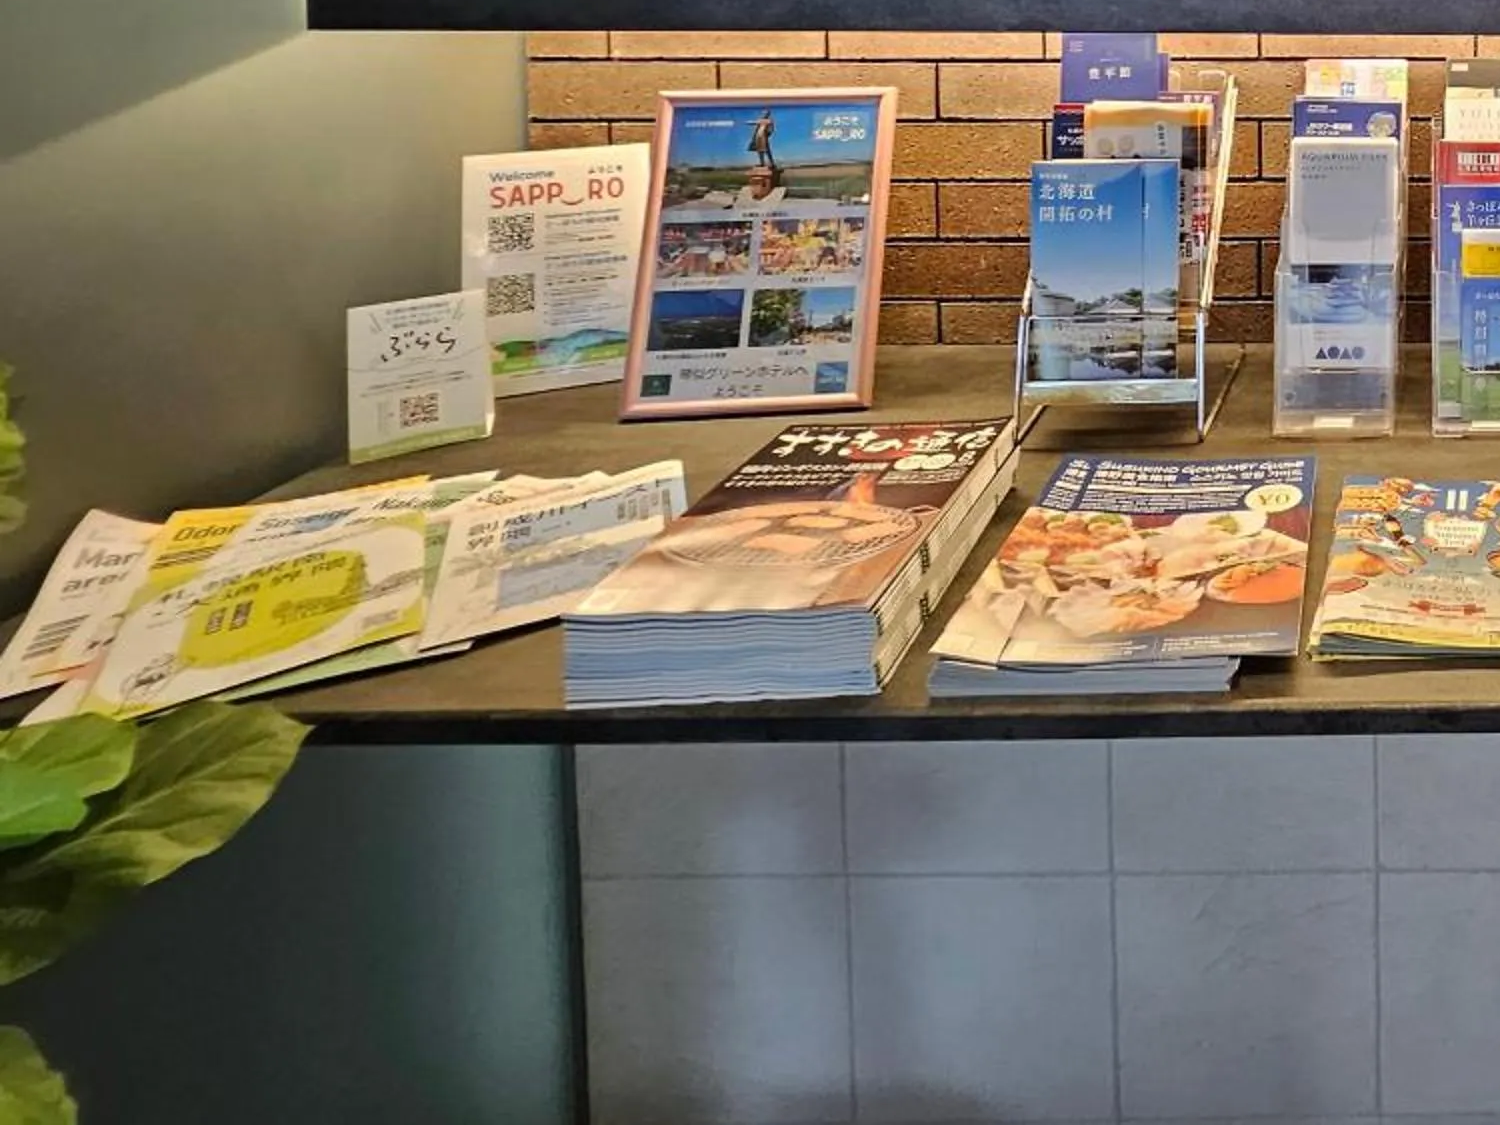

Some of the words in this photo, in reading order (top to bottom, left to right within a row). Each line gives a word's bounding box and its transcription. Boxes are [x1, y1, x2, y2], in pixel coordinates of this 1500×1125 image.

[489, 170, 555, 183] Welcome
[1038, 183, 1096, 202] 北海道
[1038, 205, 1114, 223] 開拓の村
